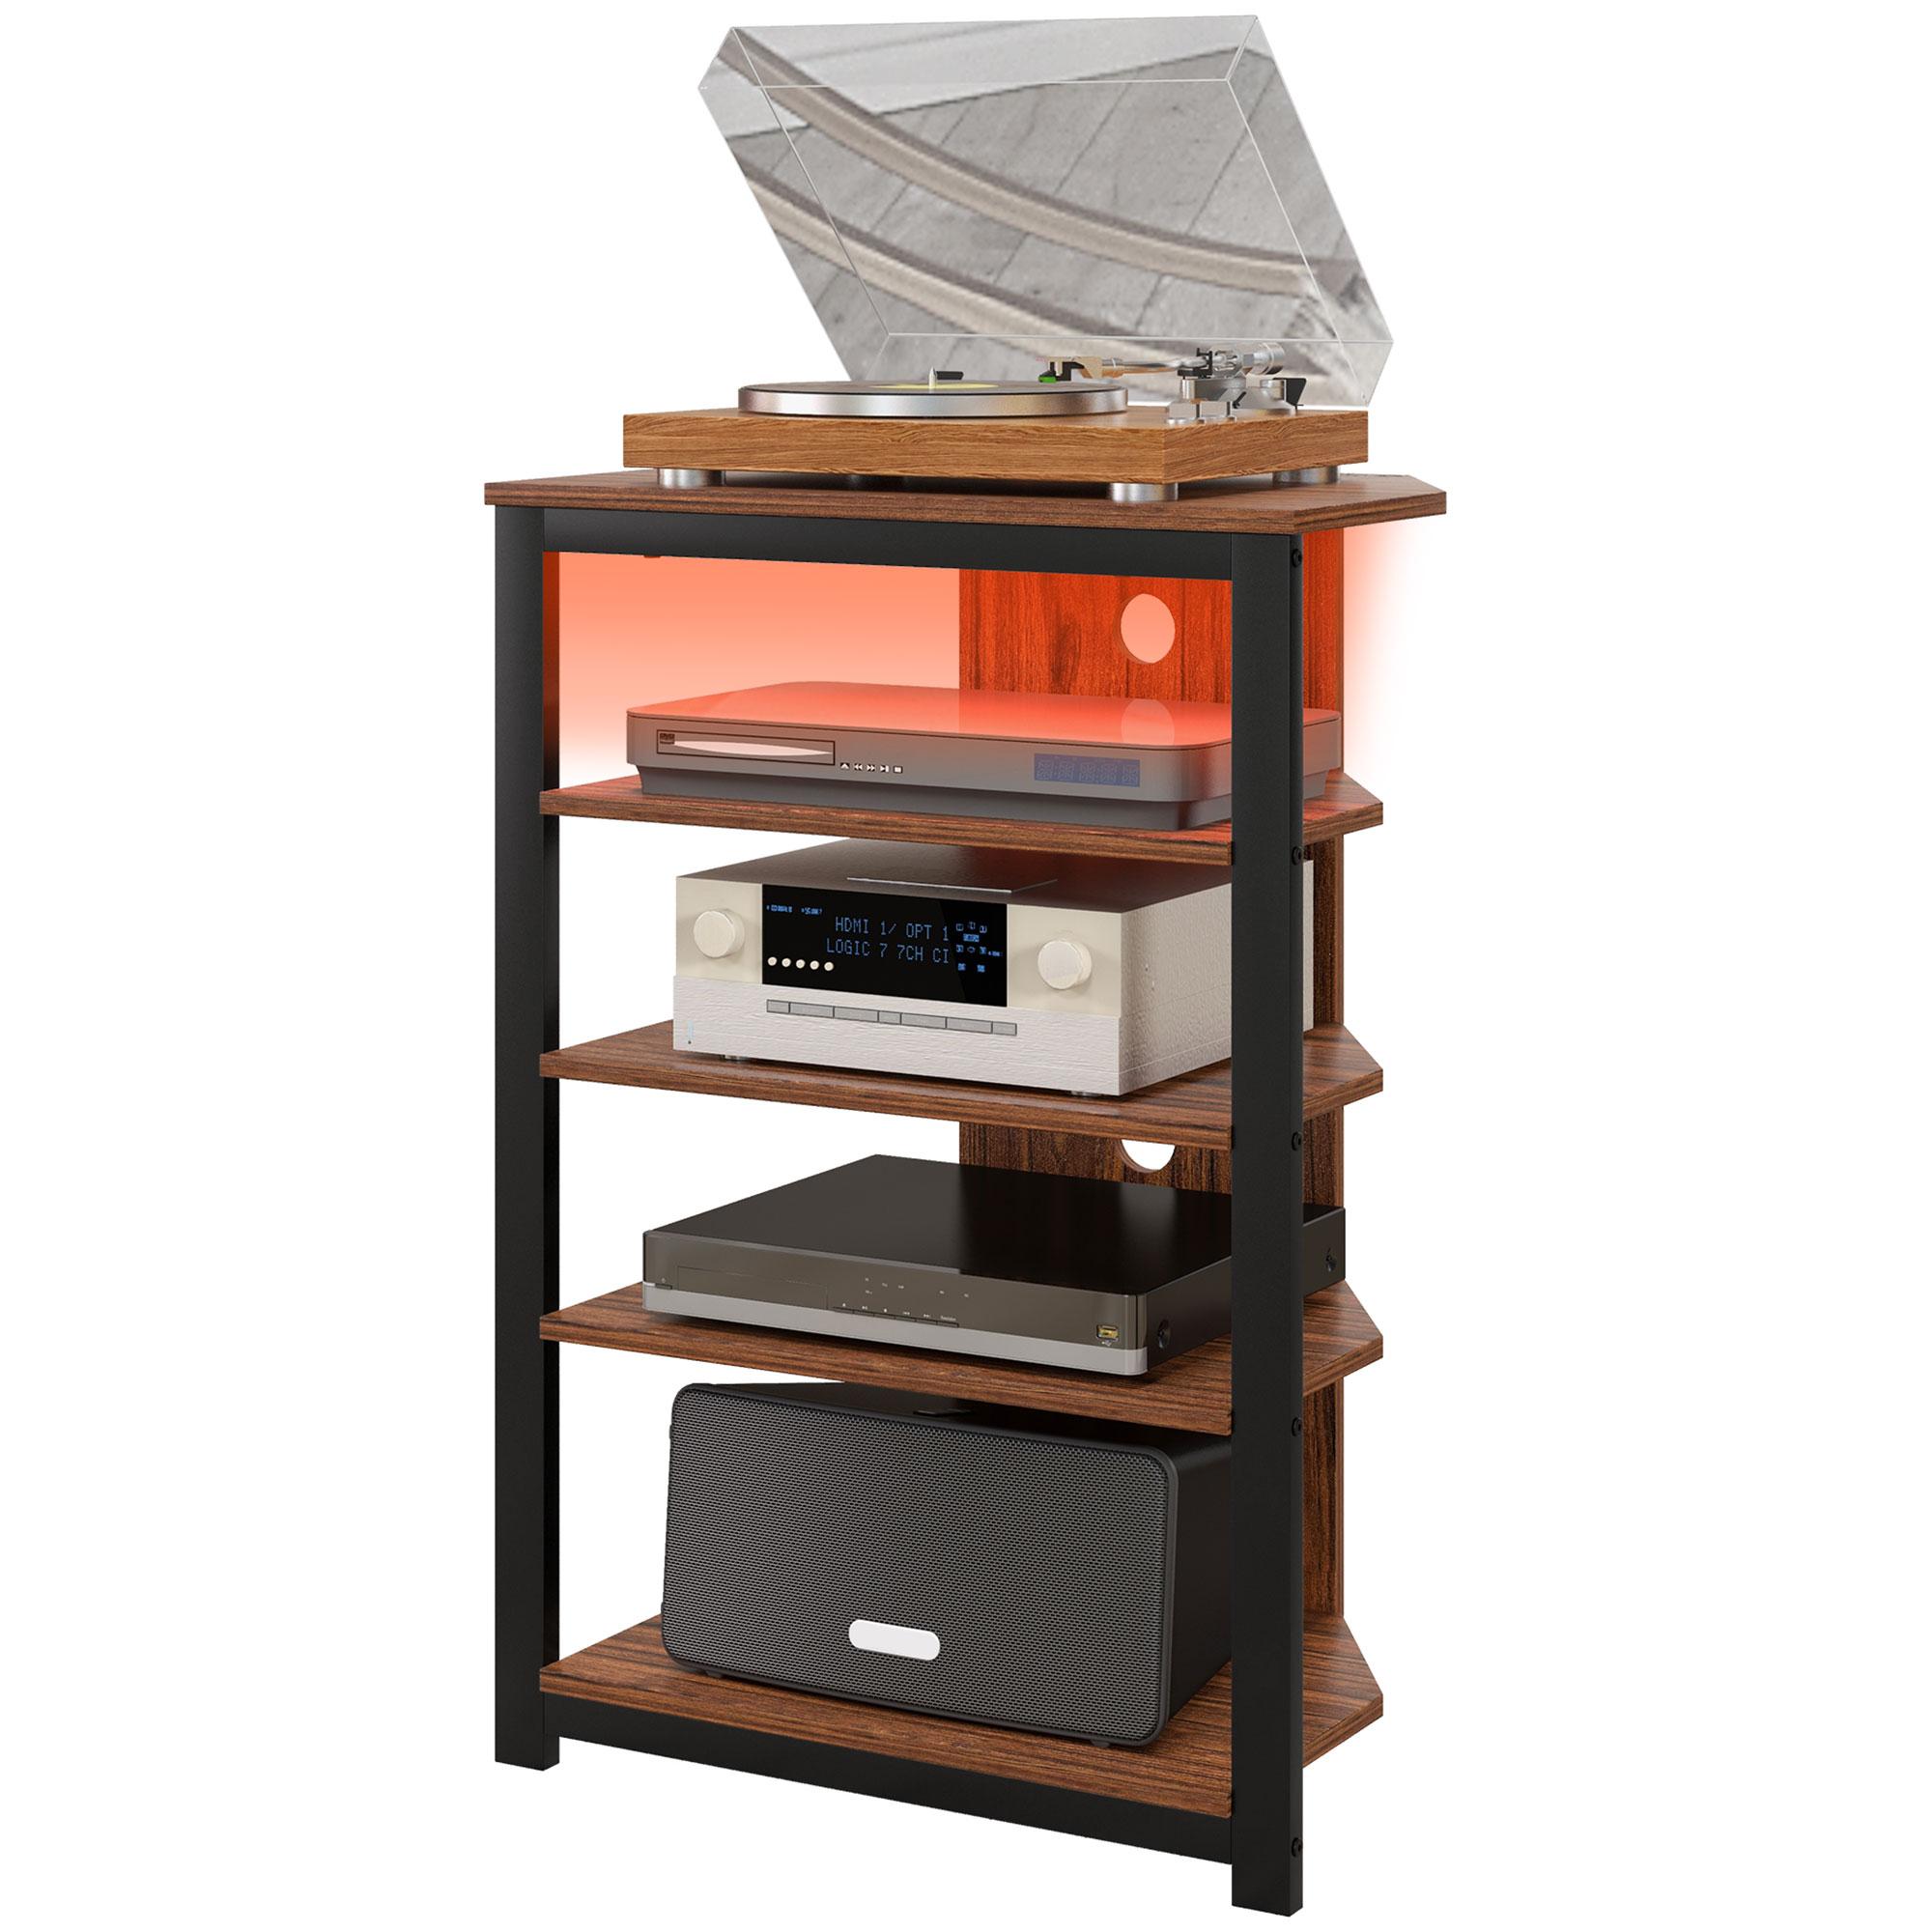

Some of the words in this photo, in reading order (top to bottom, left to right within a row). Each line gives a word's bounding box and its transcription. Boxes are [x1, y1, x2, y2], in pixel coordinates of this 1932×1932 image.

[836, 917, 868, 933] HDMI
[906, 923, 932, 939] OPT
[943, 925, 949, 941] 1
[827, 937, 869, 956] LOGIC
[879, 943, 888, 957] 7
[897, 944, 923, 961] 7CH
[932, 948, 949, 963] CI
